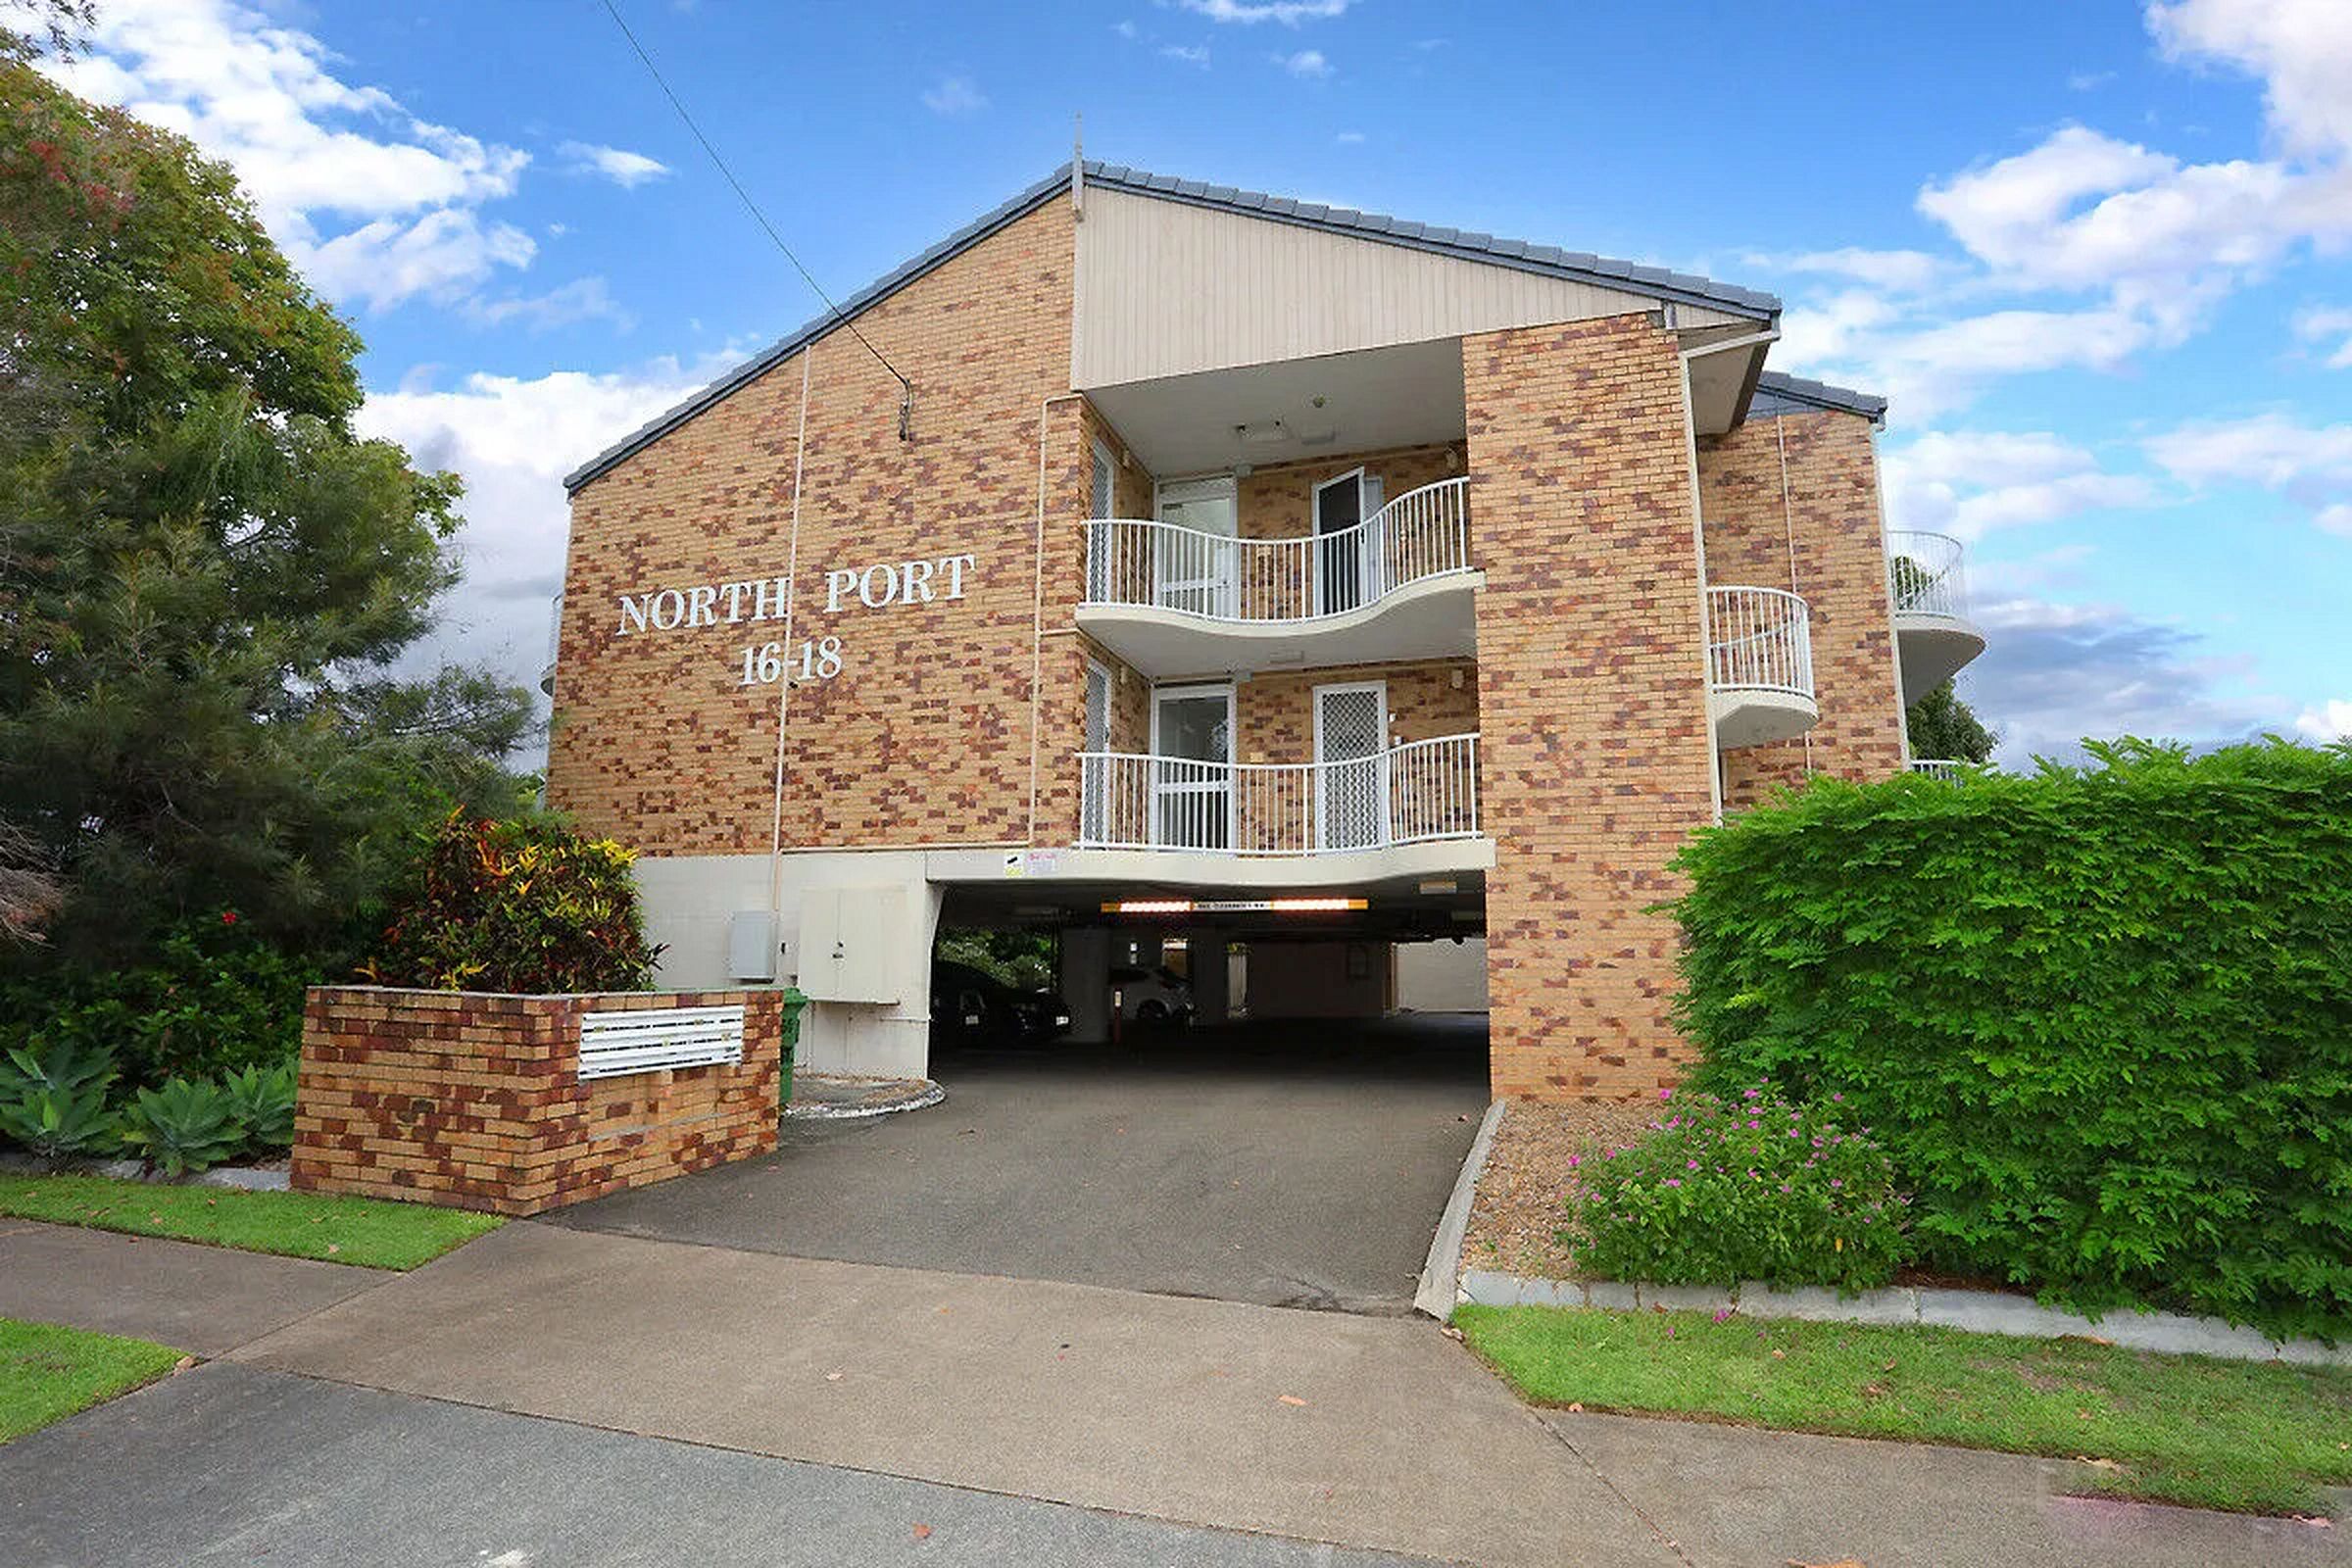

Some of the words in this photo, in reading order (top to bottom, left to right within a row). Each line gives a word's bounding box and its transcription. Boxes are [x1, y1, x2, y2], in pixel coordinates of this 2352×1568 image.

[615, 577, 791, 636] NORTH
[822, 555, 975, 613] PORT
[738, 637, 843, 686] 16-18
